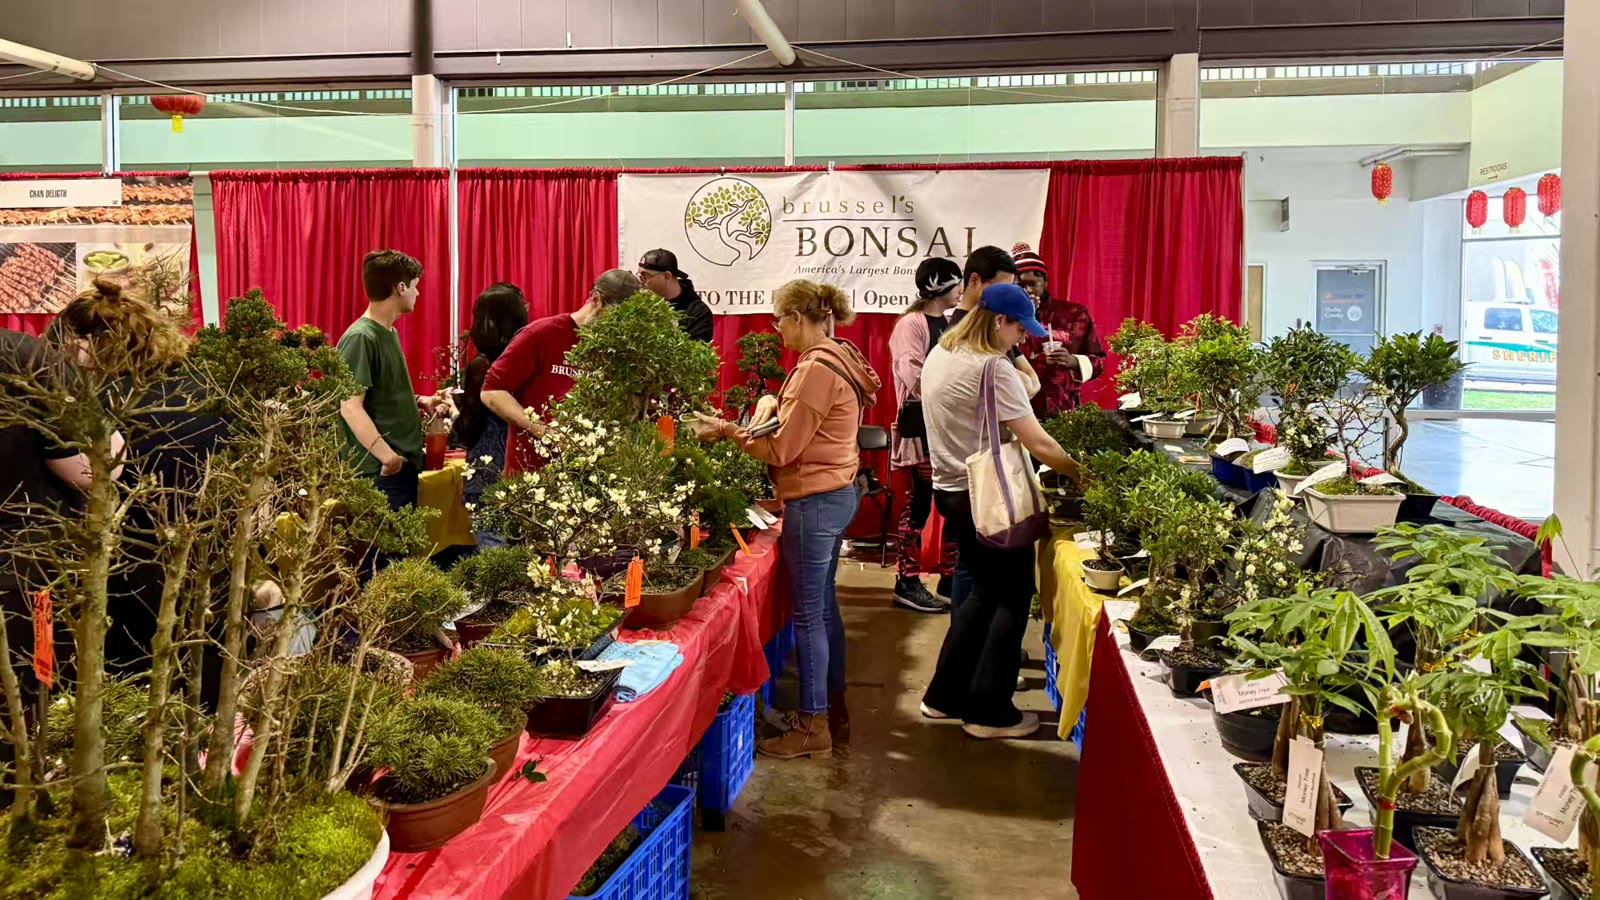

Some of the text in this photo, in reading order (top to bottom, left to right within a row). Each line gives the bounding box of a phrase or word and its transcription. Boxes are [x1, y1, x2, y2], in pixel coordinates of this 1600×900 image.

[1479, 162, 1508, 176] RESTROOMS
[29, 189, 45, 199] CHAN
[782, 195, 915, 215] brussel's
[795, 225, 977, 258] BONSAI
[793, 264, 846, 276] America's
[849, 264, 890, 278] Largest
[696, 290, 721, 306] TO
[725, 290, 765, 305] THE
[863, 289, 910, 307] Open
[1237, 690, 1257, 698] Money
[1300, 783, 1309, 805] Money
[1559, 793, 1576, 815] Money
